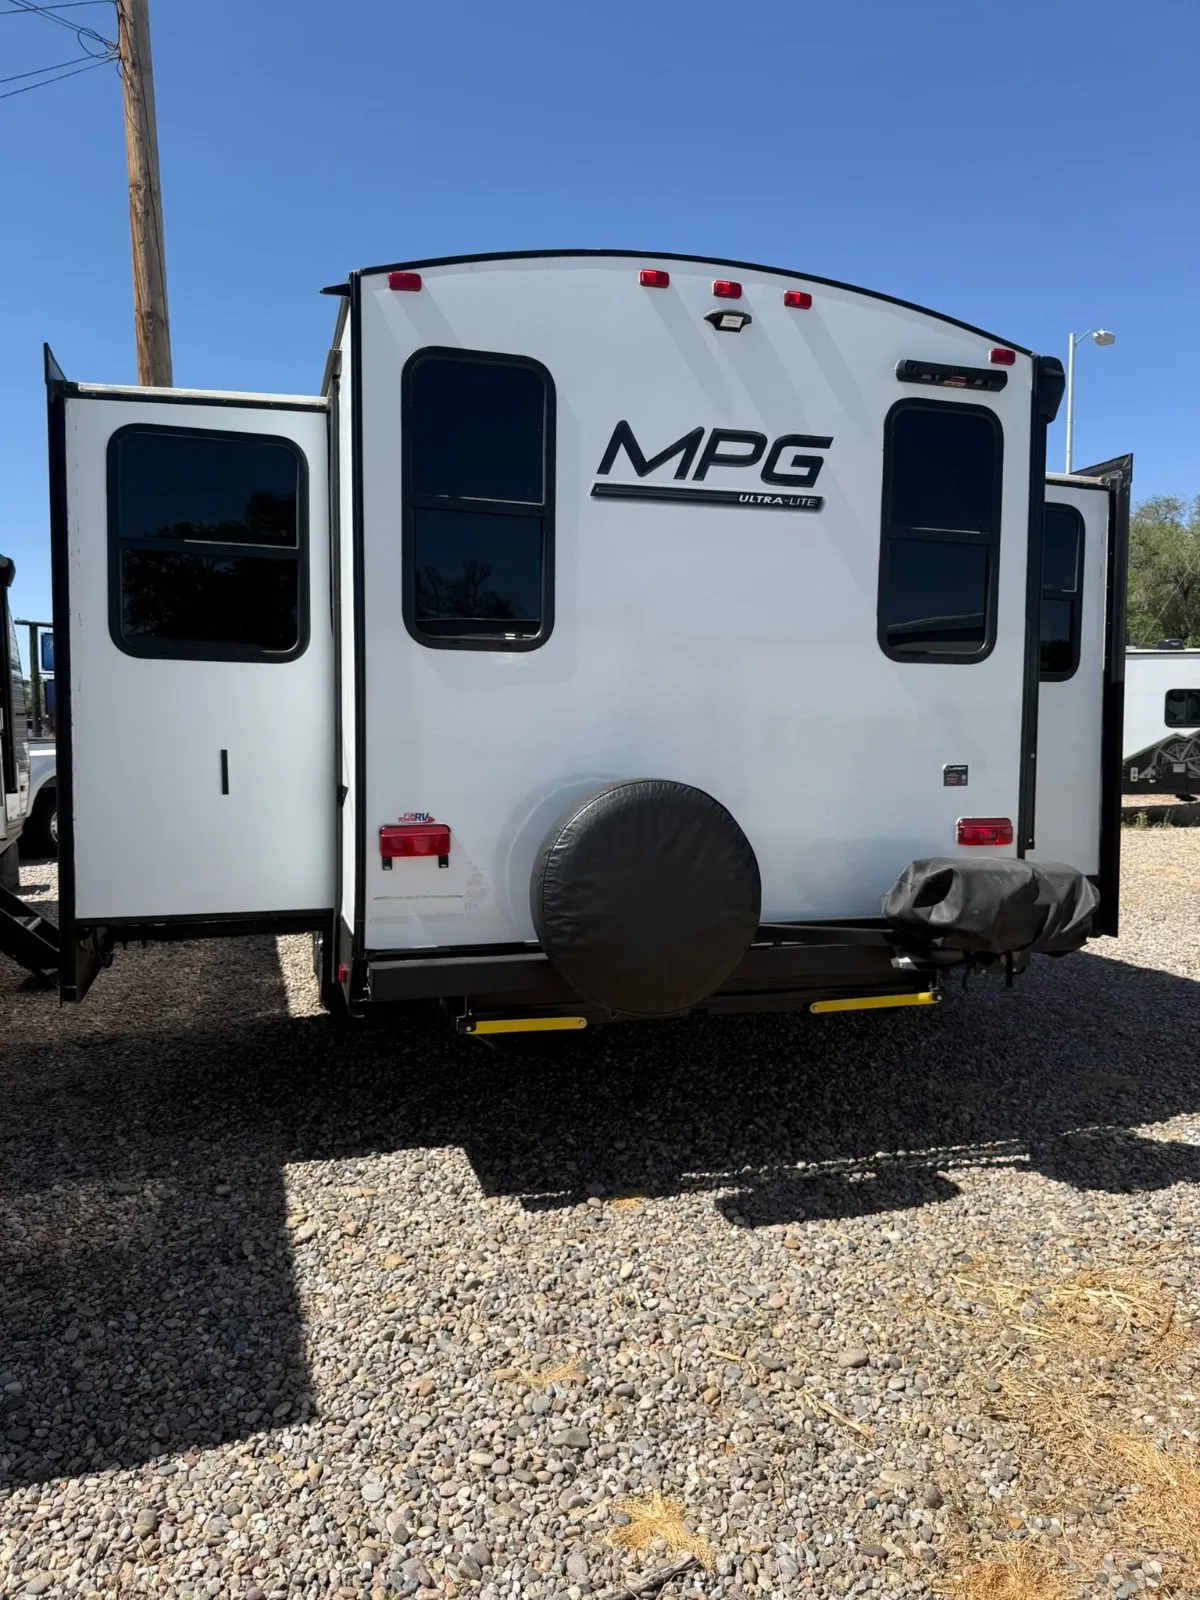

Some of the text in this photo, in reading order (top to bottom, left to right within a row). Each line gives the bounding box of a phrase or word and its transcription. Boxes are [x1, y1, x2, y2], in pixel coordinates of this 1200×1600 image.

[596, 419, 834, 488] MPG
[739, 494, 816, 507] ULTRA-LITE
[415, 812, 430, 821] RV
